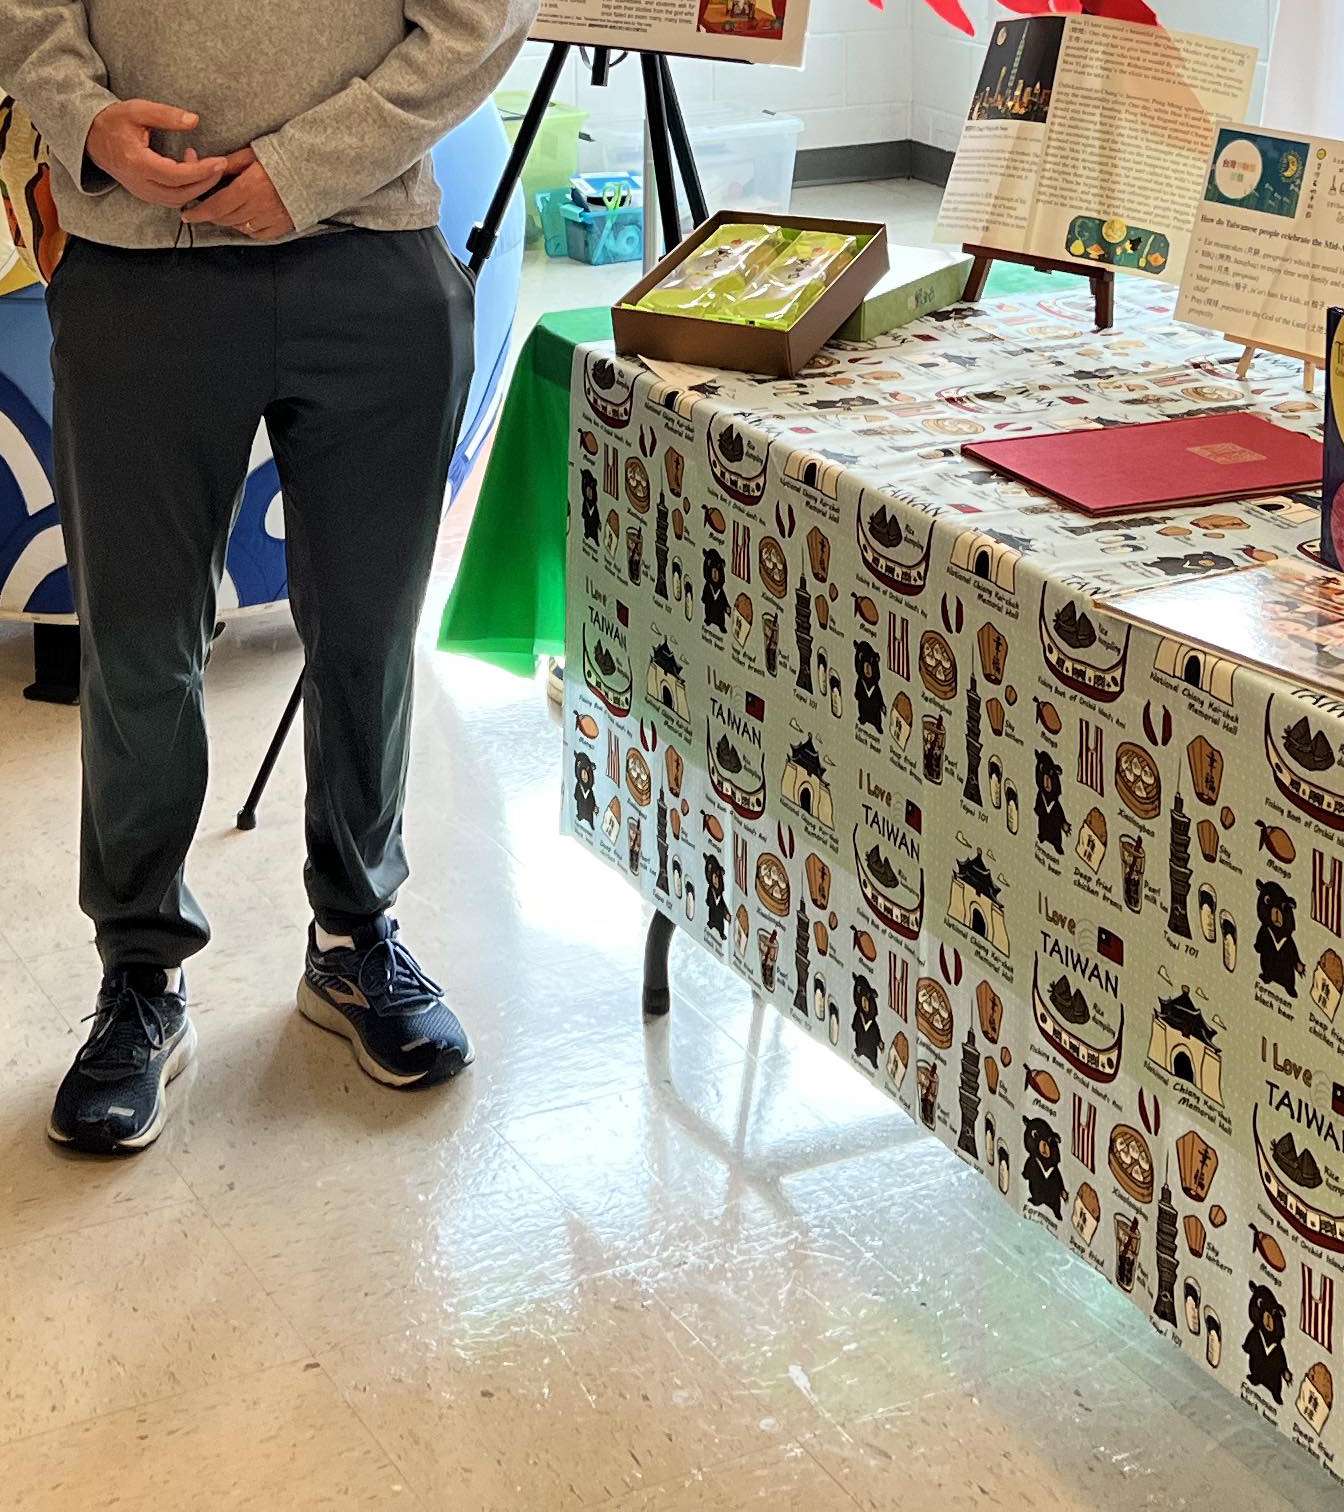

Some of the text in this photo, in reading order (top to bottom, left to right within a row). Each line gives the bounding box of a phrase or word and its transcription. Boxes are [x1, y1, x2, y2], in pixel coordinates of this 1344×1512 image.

[1201, 215, 1214, 224] How
[1216, 218, 1224, 226] do
[1226, 219, 1257, 233] Taiwanese
[1258, 227, 1280, 239] people
[1281, 231, 1311, 245] celebrate
[1312, 238, 1323, 247] the
[588, 605, 628, 651] TAIWAN
[1150, 671, 1179, 694] National
[1182, 687, 1204, 708] Chiang
[709, 697, 761, 749] TAIWAN
[1187, 701, 1238, 736] Memorial Hall
[859, 768, 892, 807] I Love
[1264, 796, 1285, 819] Fishing
[1304, 818, 1313, 829] of
[861, 804, 920, 863] TAIWAN
[1074, 867, 1092, 883] Deep
[1266, 858, 1292, 880] Mango
[1074, 879, 1099, 898] chicken
[1045, 896, 1076, 935] Love
[1040, 930, 1119, 999] TAIWAN
[1184, 944, 1199, 959] 101
[1277, 1004, 1295, 1023] bear
[1309, 1011, 1328, 1032] Deep
[1309, 1025, 1334, 1055] chicken
[1262, 1036, 1312, 1088] I Love
[1172, 1081, 1201, 1104] Chiang
[1324, 1165, 1339, 1183] Rice
[1206, 1241, 1219, 1257] Sky
